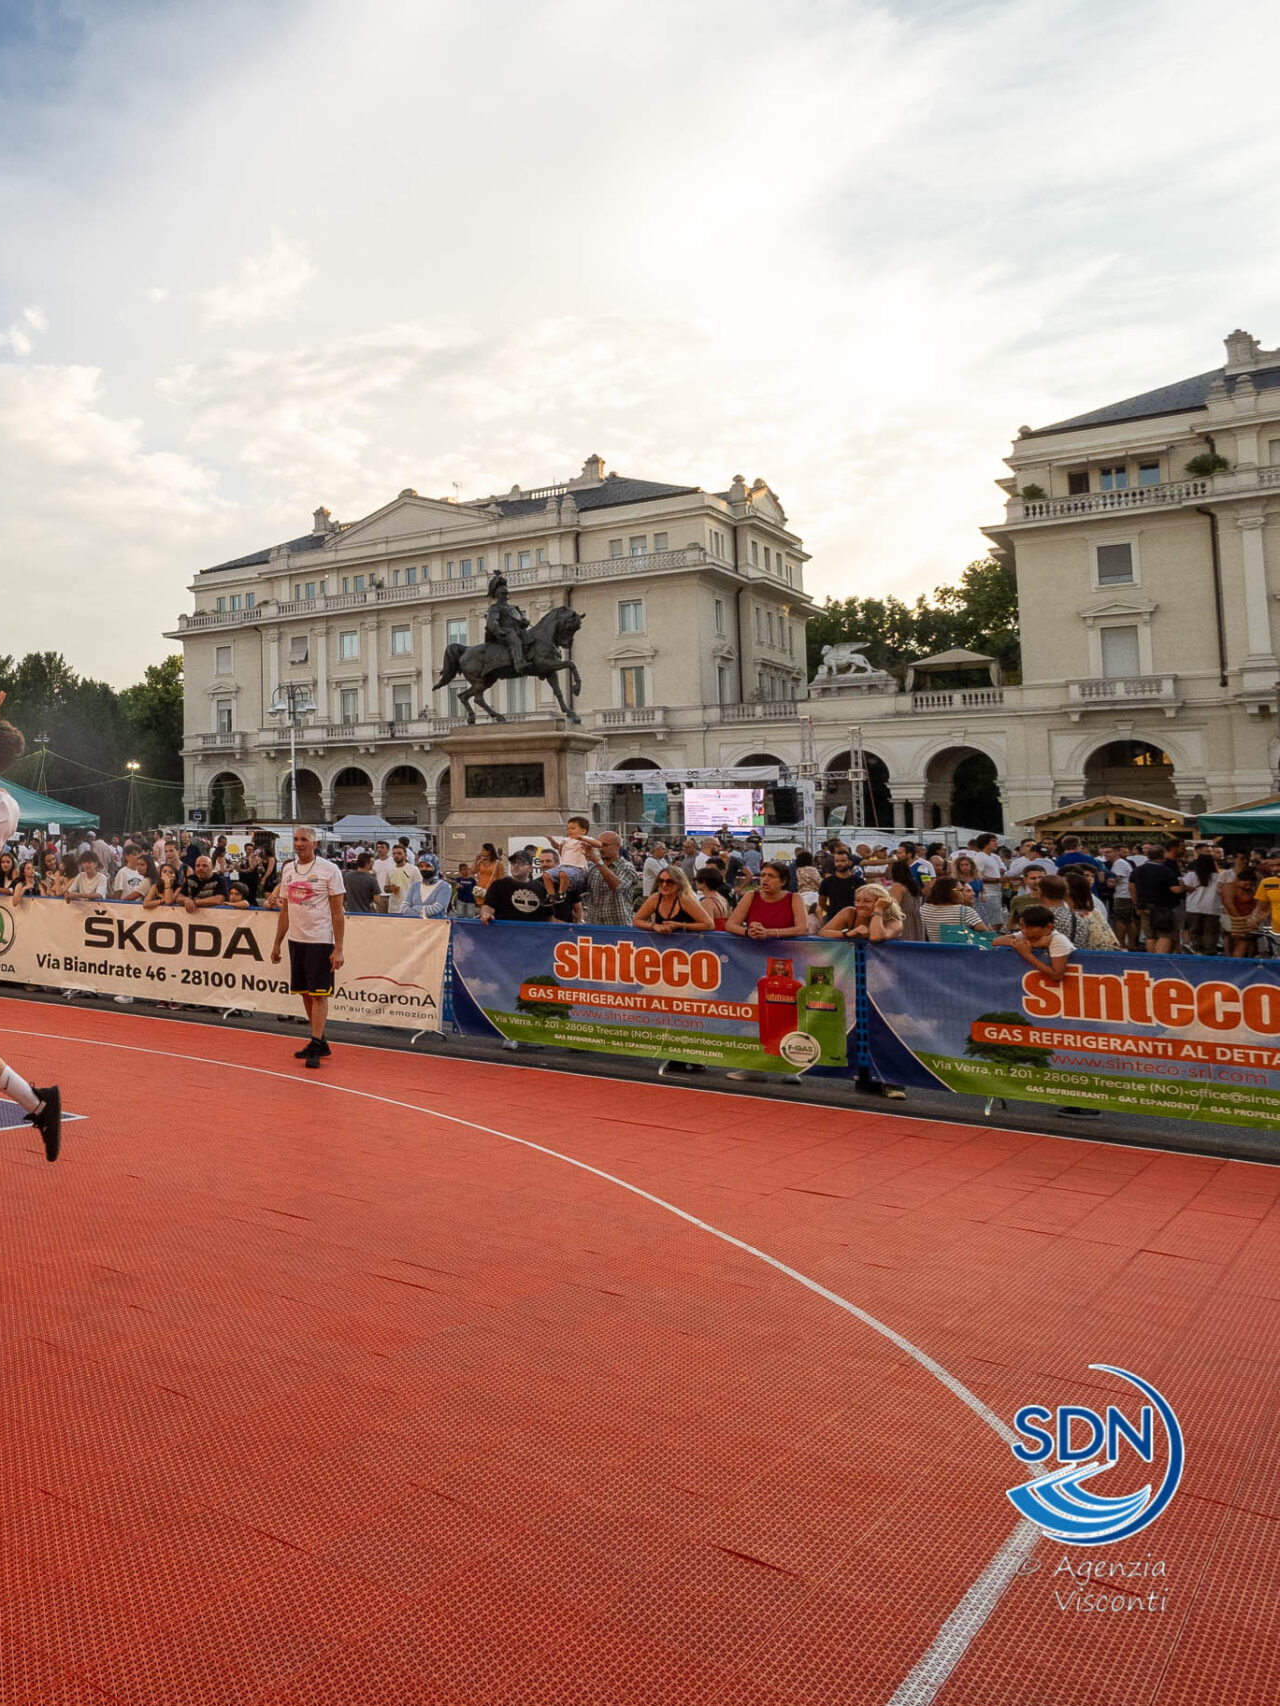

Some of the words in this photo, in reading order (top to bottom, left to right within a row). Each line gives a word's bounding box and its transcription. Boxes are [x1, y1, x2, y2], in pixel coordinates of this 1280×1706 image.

[83, 909, 264, 962] ŠKODA
[36, 953, 60, 970] Via
[63, 956, 142, 979] Biandrate
[145, 965, 166, 982] 46
[180, 969, 237, 988] 28100
[241, 974, 290, 995] Nova
[553, 935, 721, 992] sinteco
[334, 986, 437, 1008] AutoaronA
[375, 1006, 385, 1015] di
[528, 986, 554, 1000] GAS
[558, 990, 648, 1009] REFRIGERANTI
[650, 998, 669, 1011] AL
[672, 1000, 753, 1018] DETTAGLIO
[494, 1015, 508, 1024] Via
[544, 1020, 559, 1029] 201
[565, 1022, 594, 1033] 28069
[596, 1026, 628, 1037] Trecate
[570, 1008, 705, 1030] www.sinteco-srl.com
[984, 1026, 1024, 1043] GAS
[1029, 1030, 1173, 1057] REFRIGERANTI
[1180, 1044, 1209, 1060] AL
[932, 1060, 951, 1070] Via
[954, 1062, 992, 1076] Verra,
[994, 1068, 1006, 1076] n.
[1009, 1068, 1032, 1079] 201
[1042, 1072, 1089, 1085] 28069
[1092, 1077, 1146, 1092] Trecate
[1050, 1054, 1268, 1086] www.sinteco-srl.com
[1026, 1086, 1044, 1094] GAS
[1046, 1087, 1108, 1100] REFRIGERANTI
[1118, 1096, 1137, 1104] GAS
[1140, 1098, 1200, 1112] ESPANDENTI
[1210, 1106, 1231, 1115] GAS
